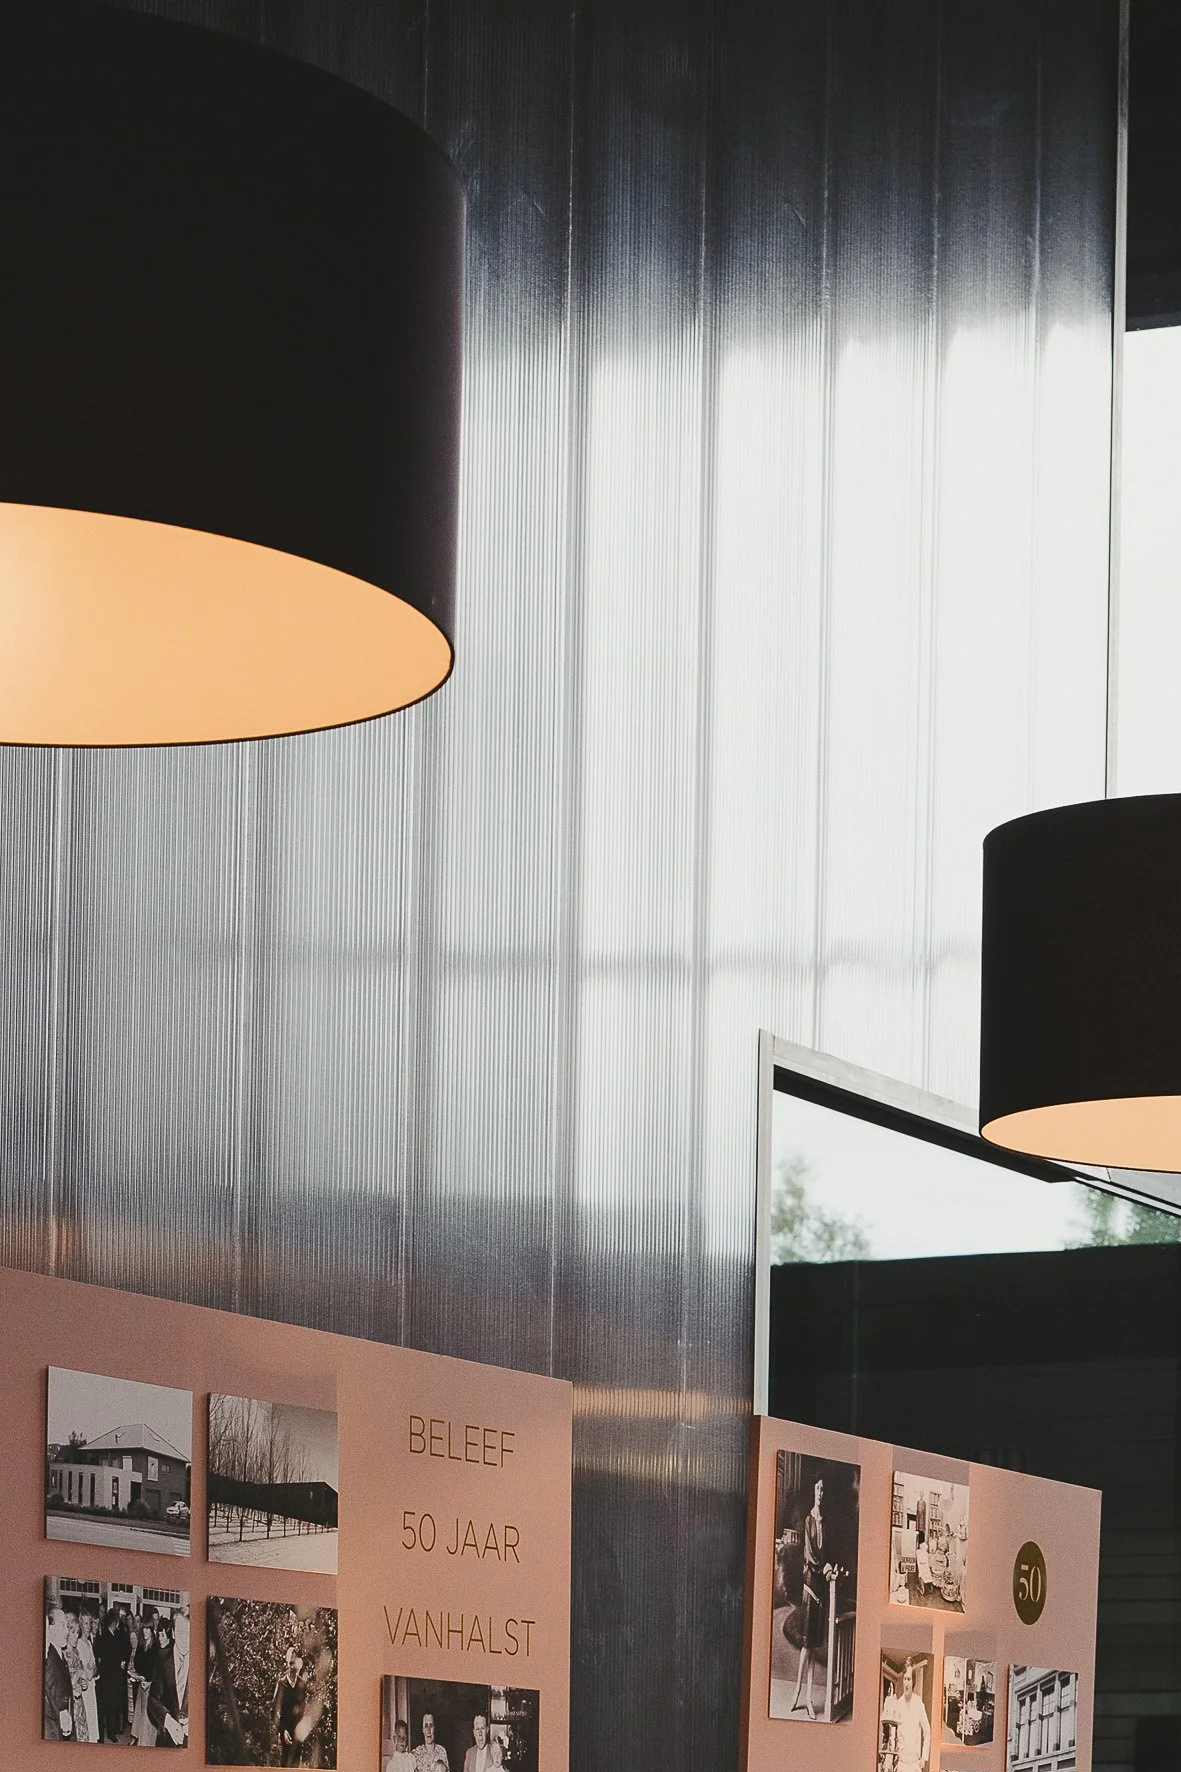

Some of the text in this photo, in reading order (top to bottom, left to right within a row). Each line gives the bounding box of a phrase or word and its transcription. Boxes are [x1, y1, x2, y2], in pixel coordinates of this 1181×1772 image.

[409, 1414, 515, 1468] BELEEF
[402, 1511, 520, 1564] 50 JAAR
[1019, 1564, 1042, 1603] 50
[384, 1605, 536, 1657] VANHALST
